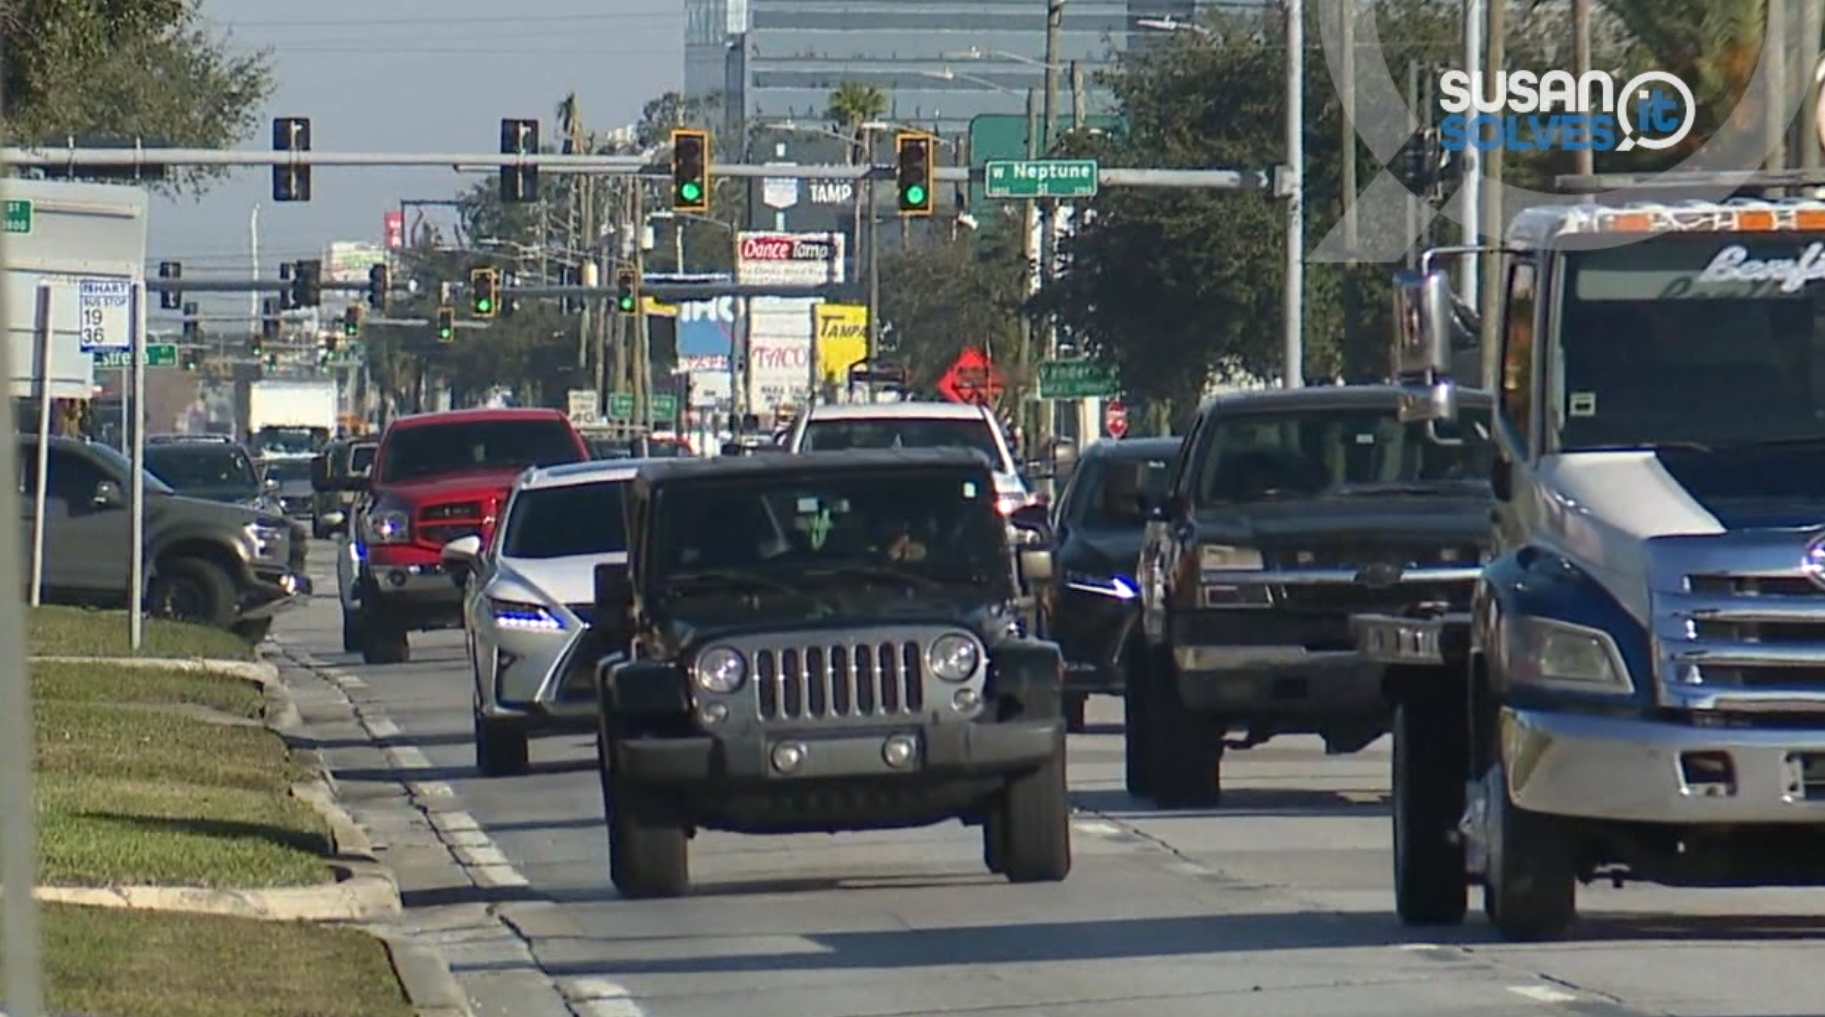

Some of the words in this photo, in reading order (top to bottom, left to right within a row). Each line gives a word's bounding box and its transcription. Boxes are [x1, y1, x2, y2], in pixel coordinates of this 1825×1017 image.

[1014, 162, 1091, 181] Neptune
[744, 240, 790, 259] Dance
[84, 308, 103, 326] 19
[83, 327, 105, 344] 36
[93, 349, 149, 367] strea
